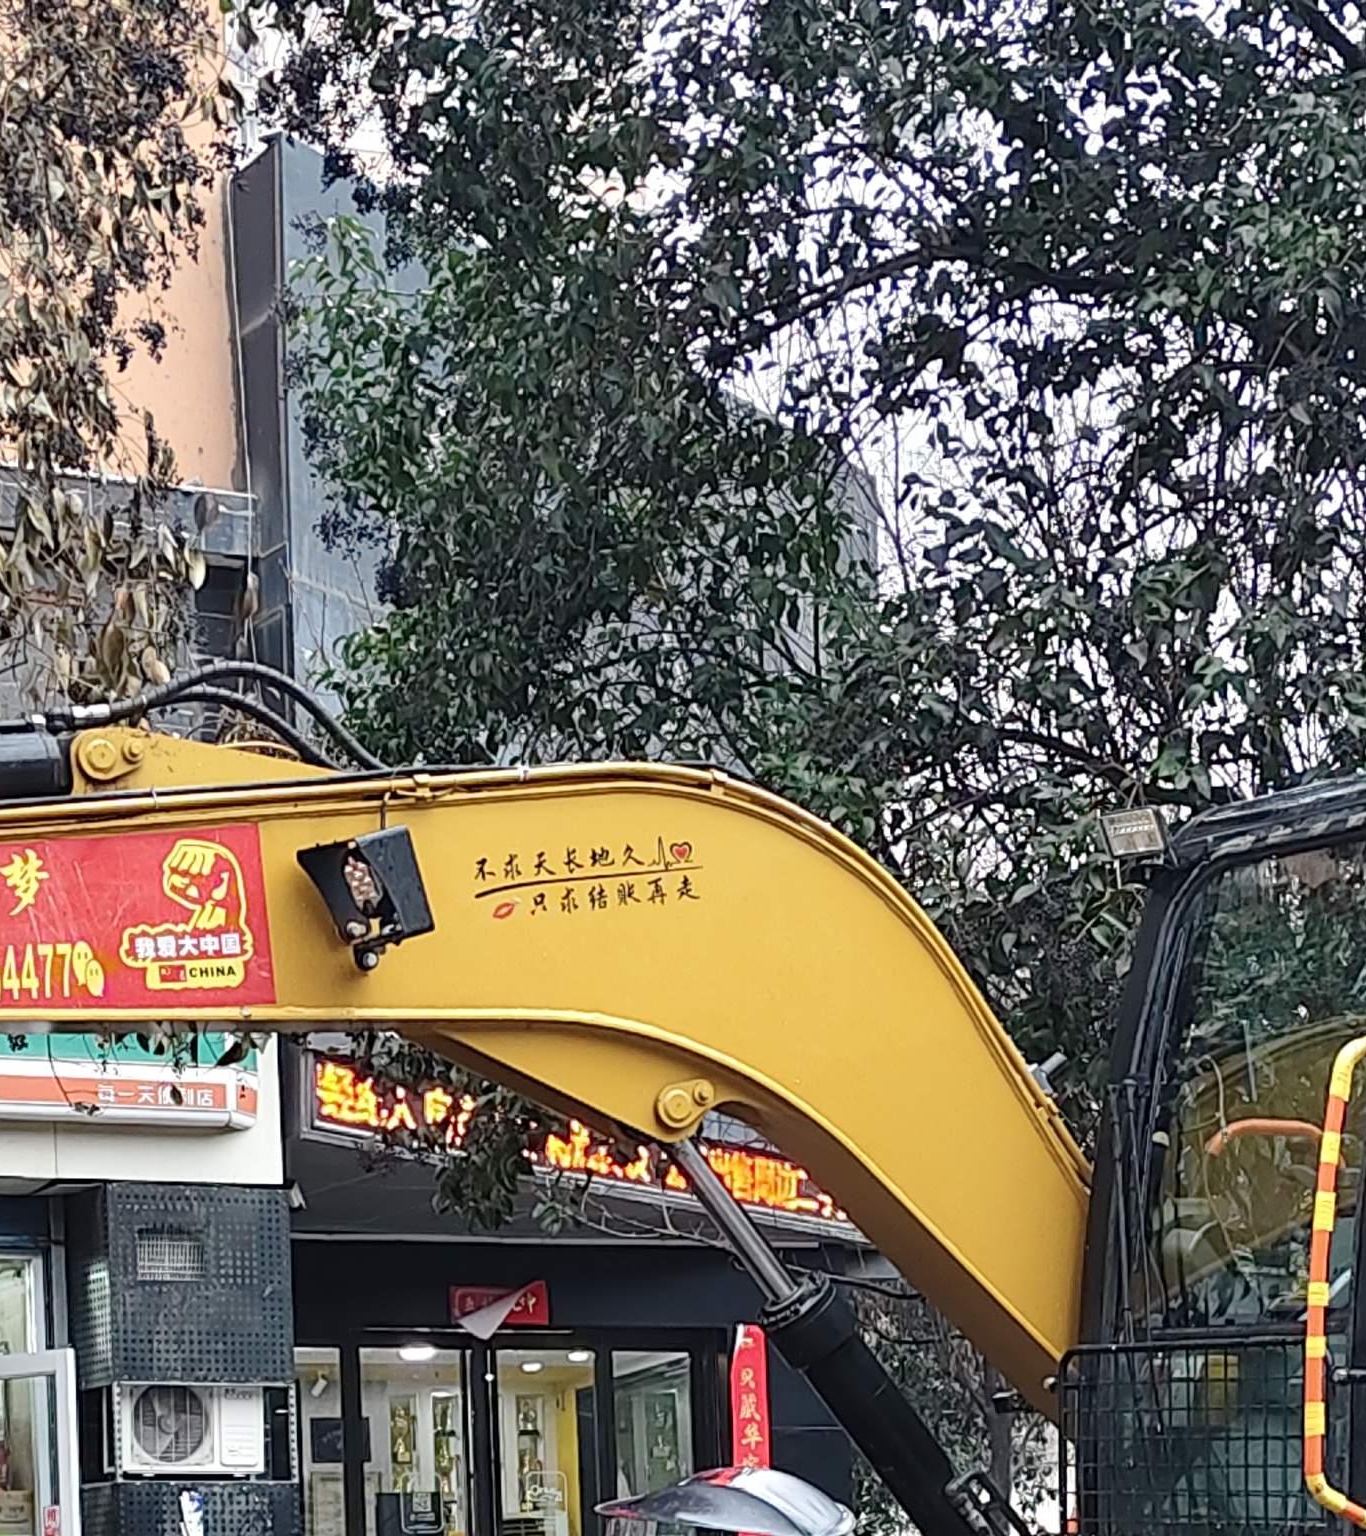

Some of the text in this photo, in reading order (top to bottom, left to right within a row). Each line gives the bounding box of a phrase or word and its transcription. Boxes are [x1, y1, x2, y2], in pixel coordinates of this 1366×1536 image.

[475, 843, 645, 881] 不求天长地久
[530, 875, 701, 917] 只求结账再走
[134, 932, 242, 959] 我爱大中国
[188, 965, 237, 979] CHINA
